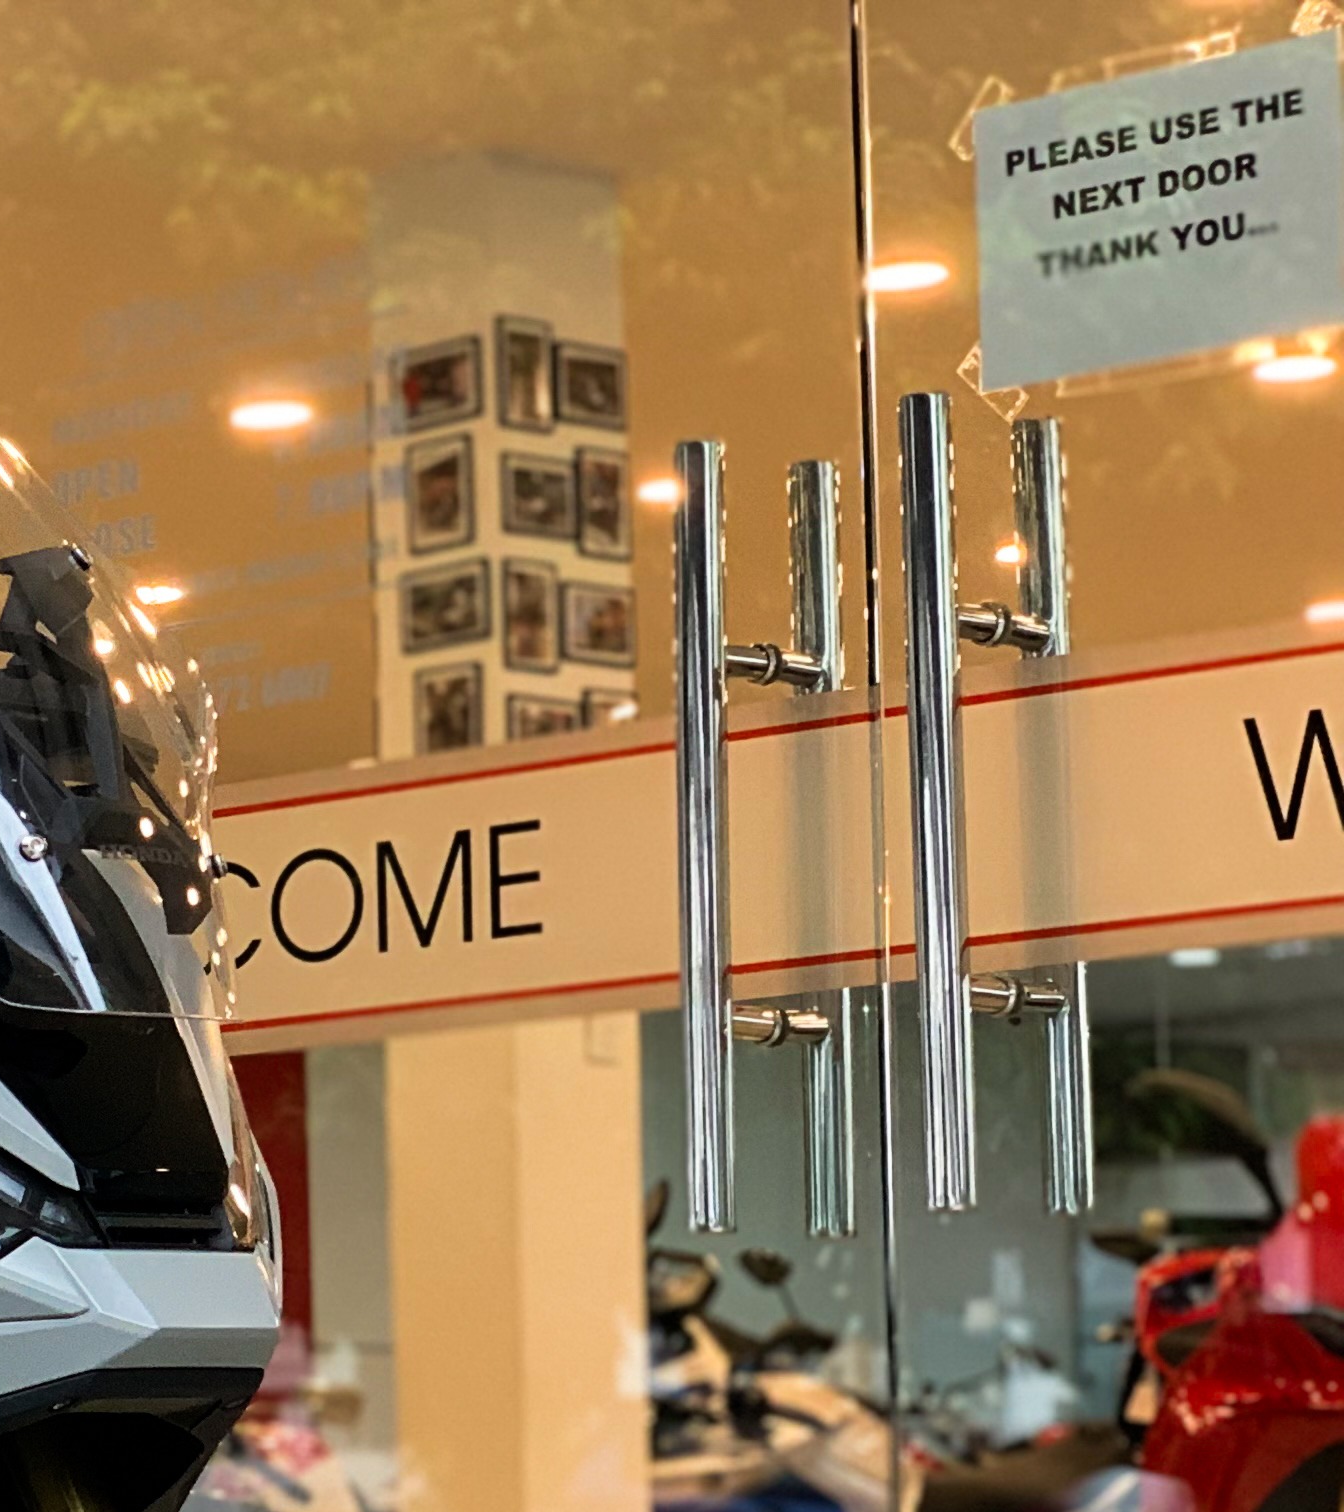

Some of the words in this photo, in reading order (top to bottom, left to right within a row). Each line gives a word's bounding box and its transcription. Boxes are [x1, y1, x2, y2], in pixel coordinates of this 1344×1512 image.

[1006, 124, 1138, 177] PLEASE
[1149, 107, 1221, 145] USE
[1231, 88, 1305, 128] THE
[1052, 176, 1146, 220] NEXT
[1157, 152, 1258, 198] DOOR
[1036, 229, 1160, 280] THANK
